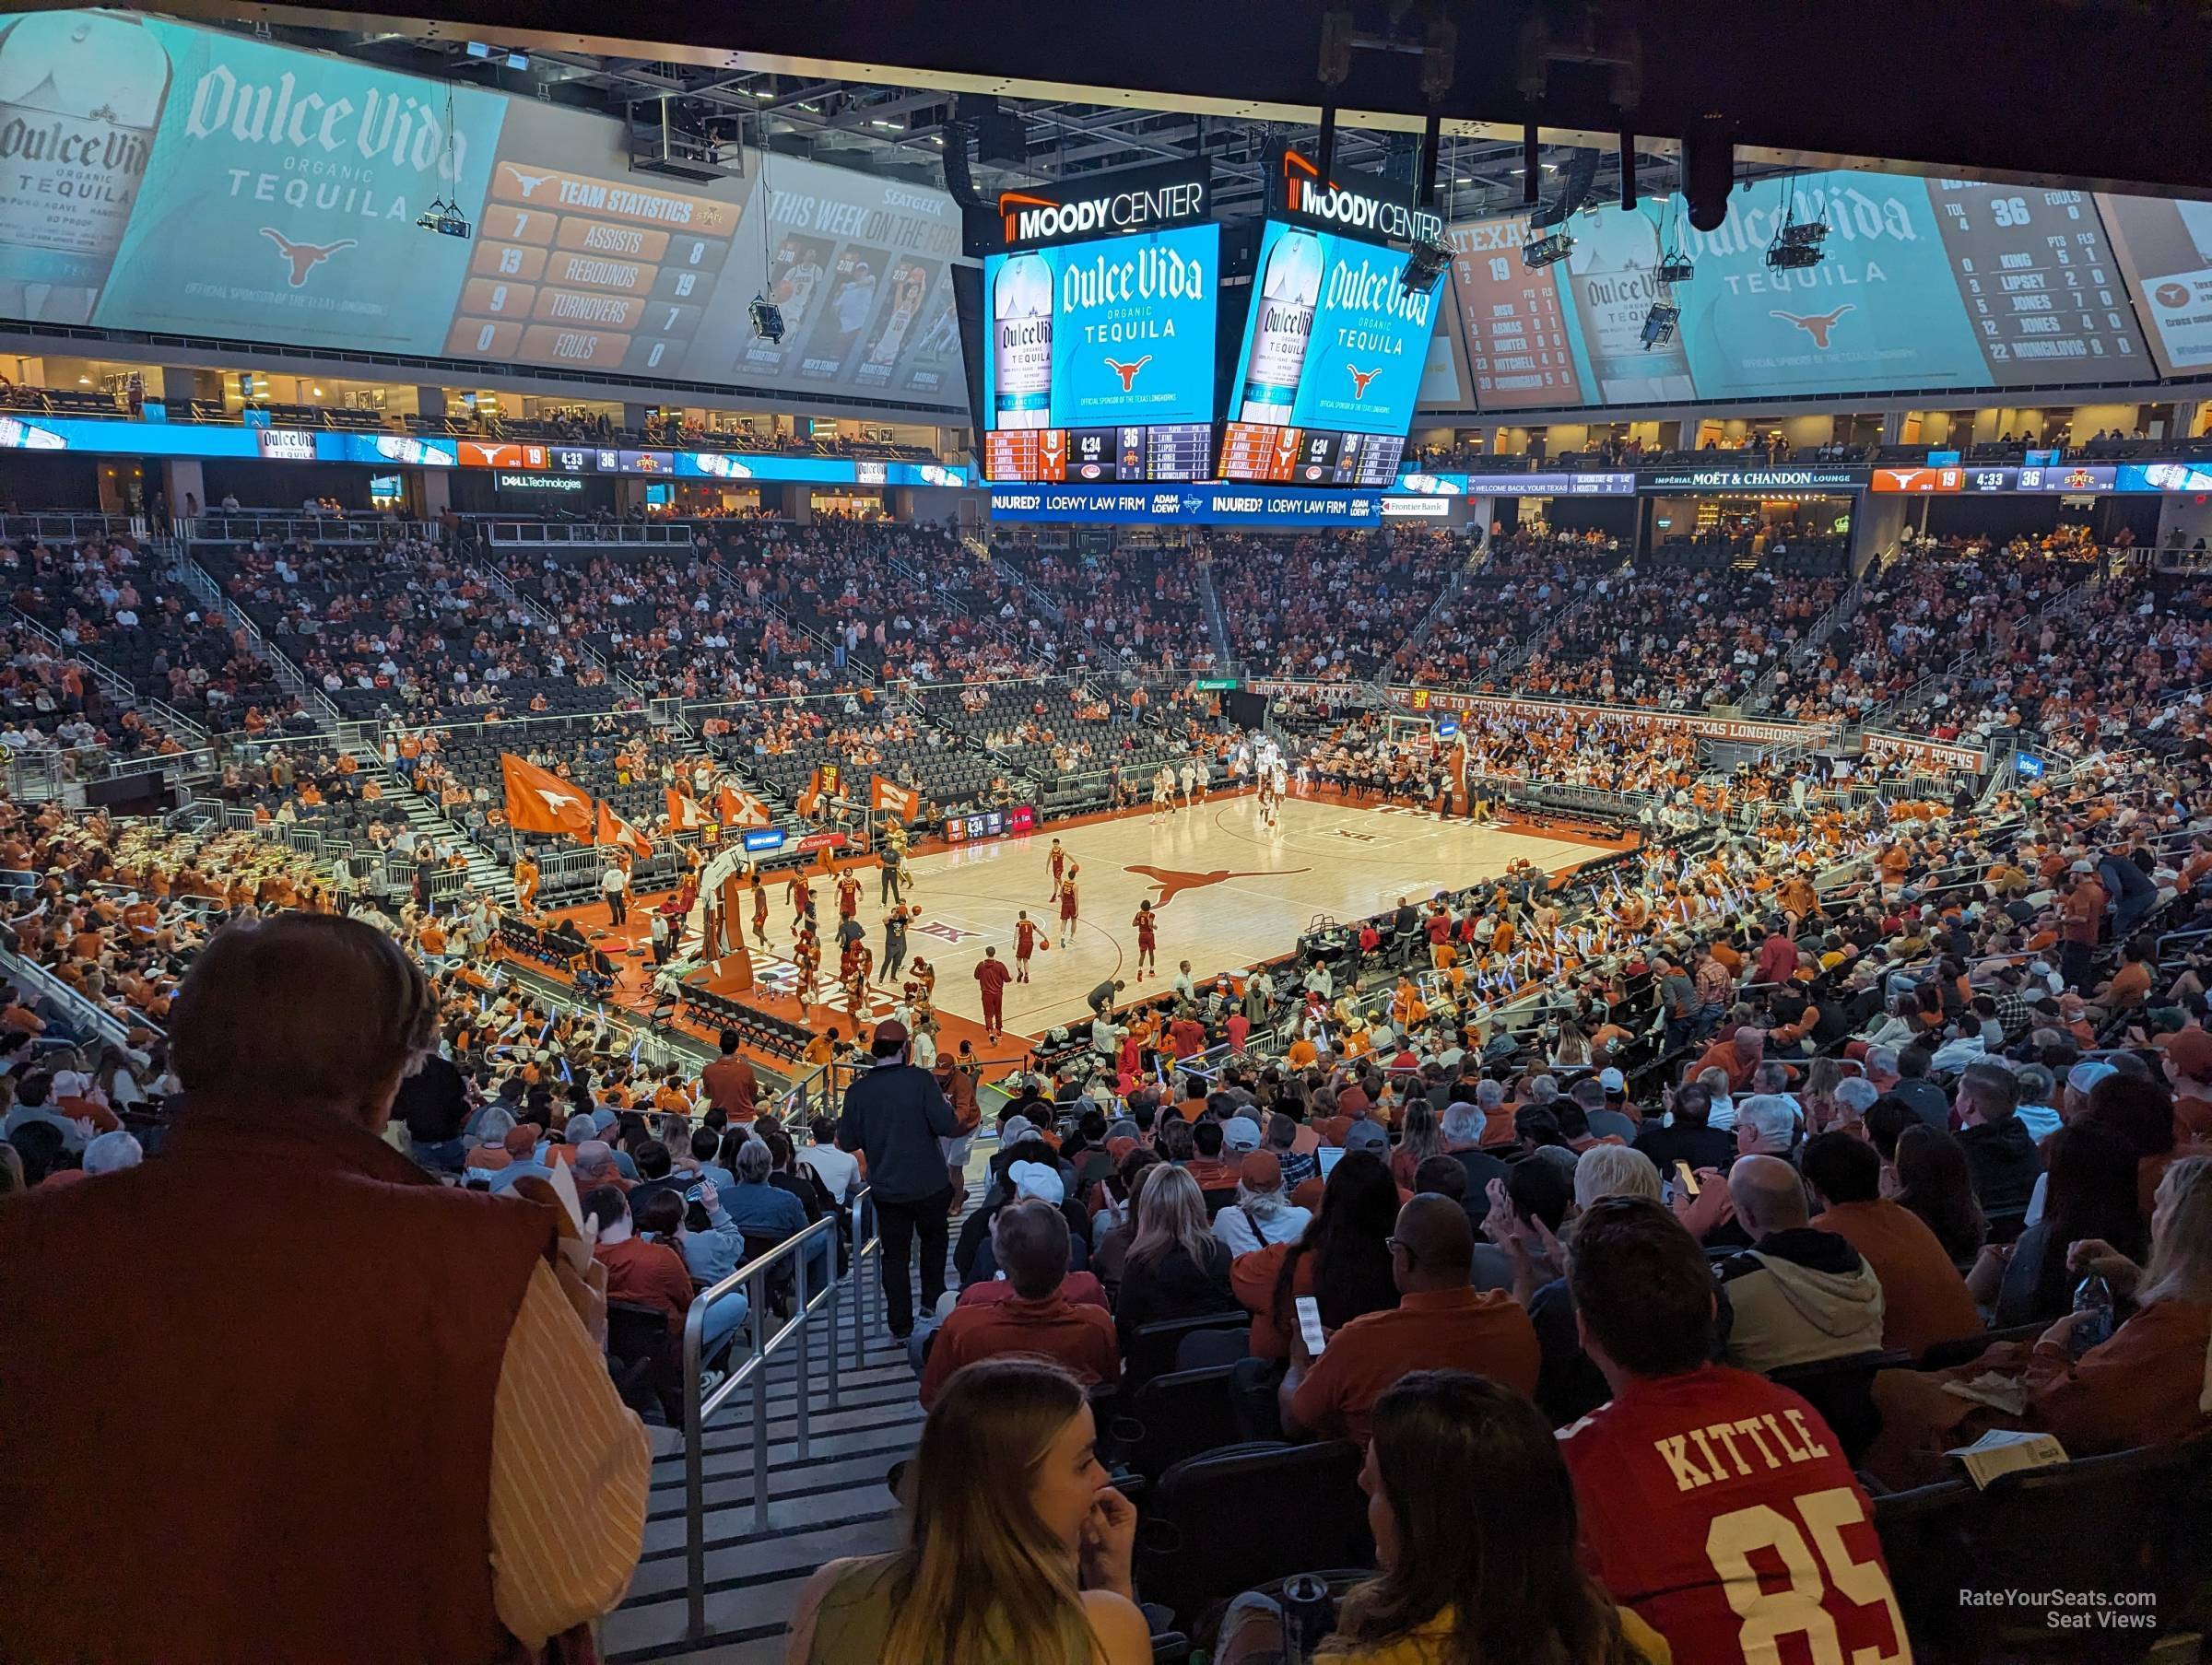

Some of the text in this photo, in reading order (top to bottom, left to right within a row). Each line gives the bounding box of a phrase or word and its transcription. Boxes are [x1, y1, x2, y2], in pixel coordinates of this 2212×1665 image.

[184, 64, 467, 183] Dulce Vida
[283, 156, 373, 182] ORGANIC
[19, 174, 130, 205] TEQUILA
[229, 169, 407, 222] TEQUILA
[559, 180, 693, 223] TEAM STATISTICS
[883, 187, 947, 217] SEATGEEK
[1945, 190, 2082, 228] TOL 36 FOULS
[1019, 182, 1203, 240] MOODY CENTER
[1302, 181, 1442, 243] MOODY CENTER
[768, 191, 927, 249] THIS WEEK ON THE
[1959, 217, 1970, 230] 4
[514, 213, 705, 264] 7 ASSISTS 8
[2047, 232, 2095, 248] PTS FLS
[1458, 257, 1511, 281] TOL 19
[1999, 252, 2032, 269] KING
[499, 248, 697, 298] 13 REBOUNDS 19
[1063, 245, 1204, 314] Dulce Vida
[1724, 261, 1888, 296] TEQUILA
[1325, 259, 1388, 314] Dulce
[2000, 274, 2046, 291] LIPSEY
[1523, 289, 1535, 299] PTS
[2012, 294, 2052, 311] JONES
[489, 286, 679, 331] 9 TURNOVERS 7
[1107, 305, 1152, 320] ORGANIC
[1264, 306, 1298, 334] Dulce
[1359, 317, 1391, 331] ORGANIC
[1982, 316, 2061, 335] 12 JONES
[1003, 323, 1035, 349] Dulce
[1084, 318, 1175, 344] TEQUILA
[553, 333, 597, 360] FOULS
[1270, 342, 1305, 356] TEQUILA
[1337, 328, 1403, 356] TEQUILA
[1493, 337, 1528, 352] HUNTER
[1012, 352, 1051, 364] TEQUILA
[1990, 343, 2009, 359] 22
[1493, 357, 1536, 371] MITCHELL
[264, 430, 298, 449] Dulce
[1046, 429, 1058, 450] 19
[1080, 436, 1101, 453] 4:34
[1124, 428, 1138, 448] 36
[1283, 428, 1295, 448] 19
[1344, 434, 1359, 452] 36
[274, 450, 314, 459] TEQUILA
[1311, 439, 1329, 455] 4:34
[528, 448, 541, 465] 19
[561, 452, 583, 466] 4:33
[601, 451, 615, 468] 36
[636, 459, 659, 468] STATE
[501, 475, 582, 489] DELL Technologies
[1692, 471, 1730, 486] MOËT
[1731, 473, 1741, 485] &
[1744, 471, 1812, 486] CHANDON
[1813, 475, 1851, 483] LOUNGE
[1942, 471, 1956, 487] 19
[1976, 473, 2004, 487] 4:33
[2021, 470, 2040, 487] 36
[2064, 475, 2095, 485] STATE
[1508, 485, 1524, 493] BACK,
[1577, 484, 1598, 492] HOUSTON
[992, 495, 1146, 511] INJURED? LOEWY LAW FIRM
[1153, 494, 1179, 504] ADAM
[1212, 497, 1347, 514] INJURED? LOEWY LAW FIRM
[1351, 499, 1369, 509] ADAM
[1391, 502, 1441, 510] Frontier Bank
[1152, 503, 1180, 514] LOEWY
[1350, 508, 1370, 517] LOEWY
[1392, 690, 1446, 708] WEME
[1450, 696, 1465, 709] TO
[1413, 698, 1426, 709] 30
[1636, 714, 1652, 728] OF
[1656, 718, 1680, 732] THE
[1683, 720, 1727, 735] TEXAS
[823, 766, 836, 777] 4:33
[822, 777, 835, 791] 30
[705, 824, 718, 833] 4:33
[968, 820, 983, 833] 4:34
[705, 832, 717, 843] 30
[1063, 885, 1071, 895] 22
[1654, 1408, 1830, 1493] KITTLE
[1705, 1486, 1913, 1665] 85
